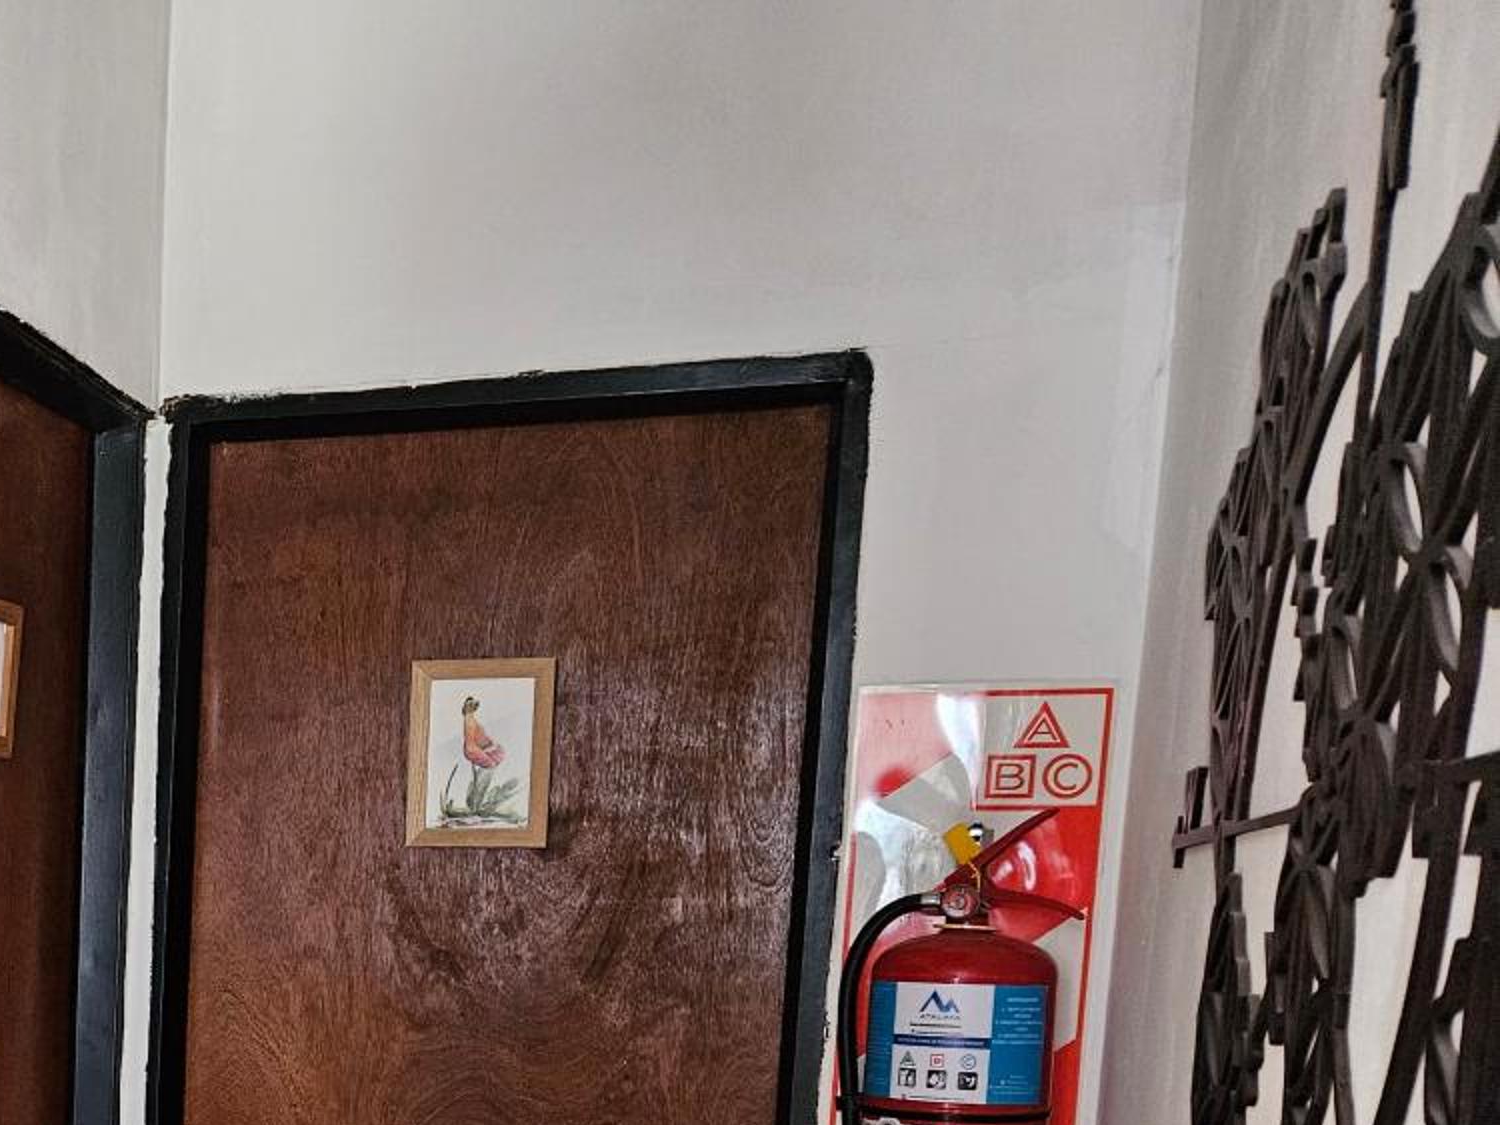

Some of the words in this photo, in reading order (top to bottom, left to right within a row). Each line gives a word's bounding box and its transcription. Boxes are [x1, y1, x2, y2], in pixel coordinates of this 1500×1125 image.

[1027, 719, 1058, 741] A
[995, 763, 1025, 790] B
[1053, 762, 1079, 791] C
